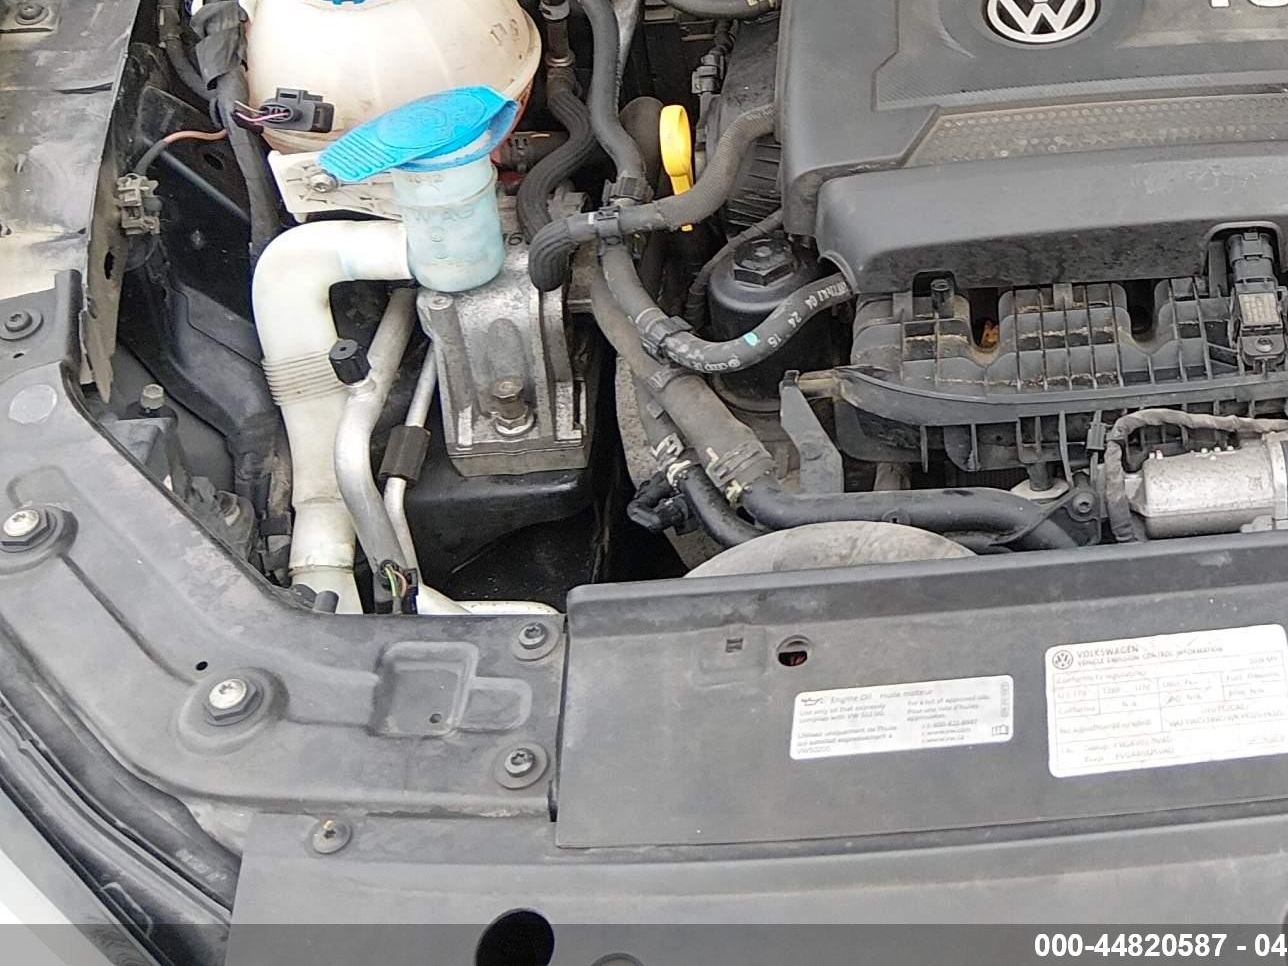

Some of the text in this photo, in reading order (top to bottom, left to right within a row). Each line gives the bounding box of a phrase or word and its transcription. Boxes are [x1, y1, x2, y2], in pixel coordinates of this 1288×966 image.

[1076, 644, 1138, 658] VOLKSWAGEN
[830, 694, 858, 704] Engine
[859, 692, 872, 700] Oil
